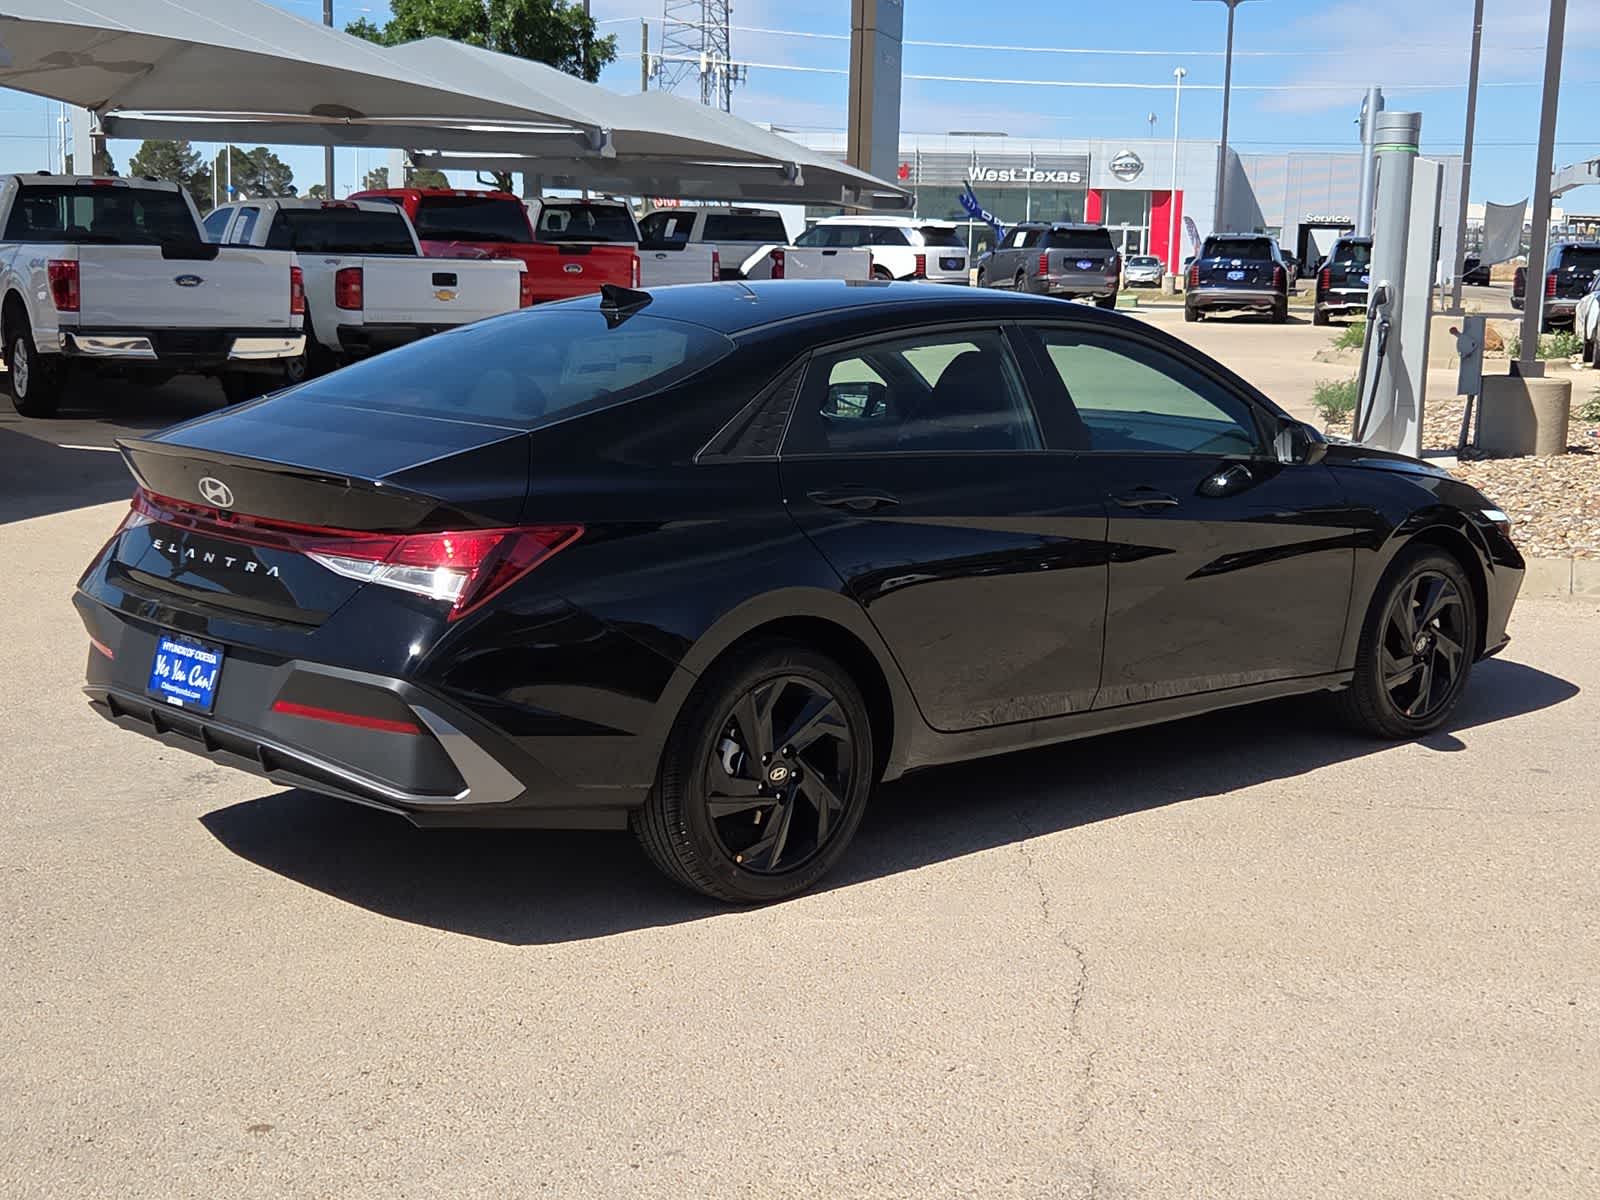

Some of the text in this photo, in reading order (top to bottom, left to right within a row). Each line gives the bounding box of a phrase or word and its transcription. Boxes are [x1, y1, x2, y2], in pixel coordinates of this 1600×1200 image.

[967, 167, 1081, 183] West Texas
[1306, 213, 1350, 224] Service
[152, 538, 280, 578] ELANTRA
[155, 655, 217, 691] Yes You Can!
